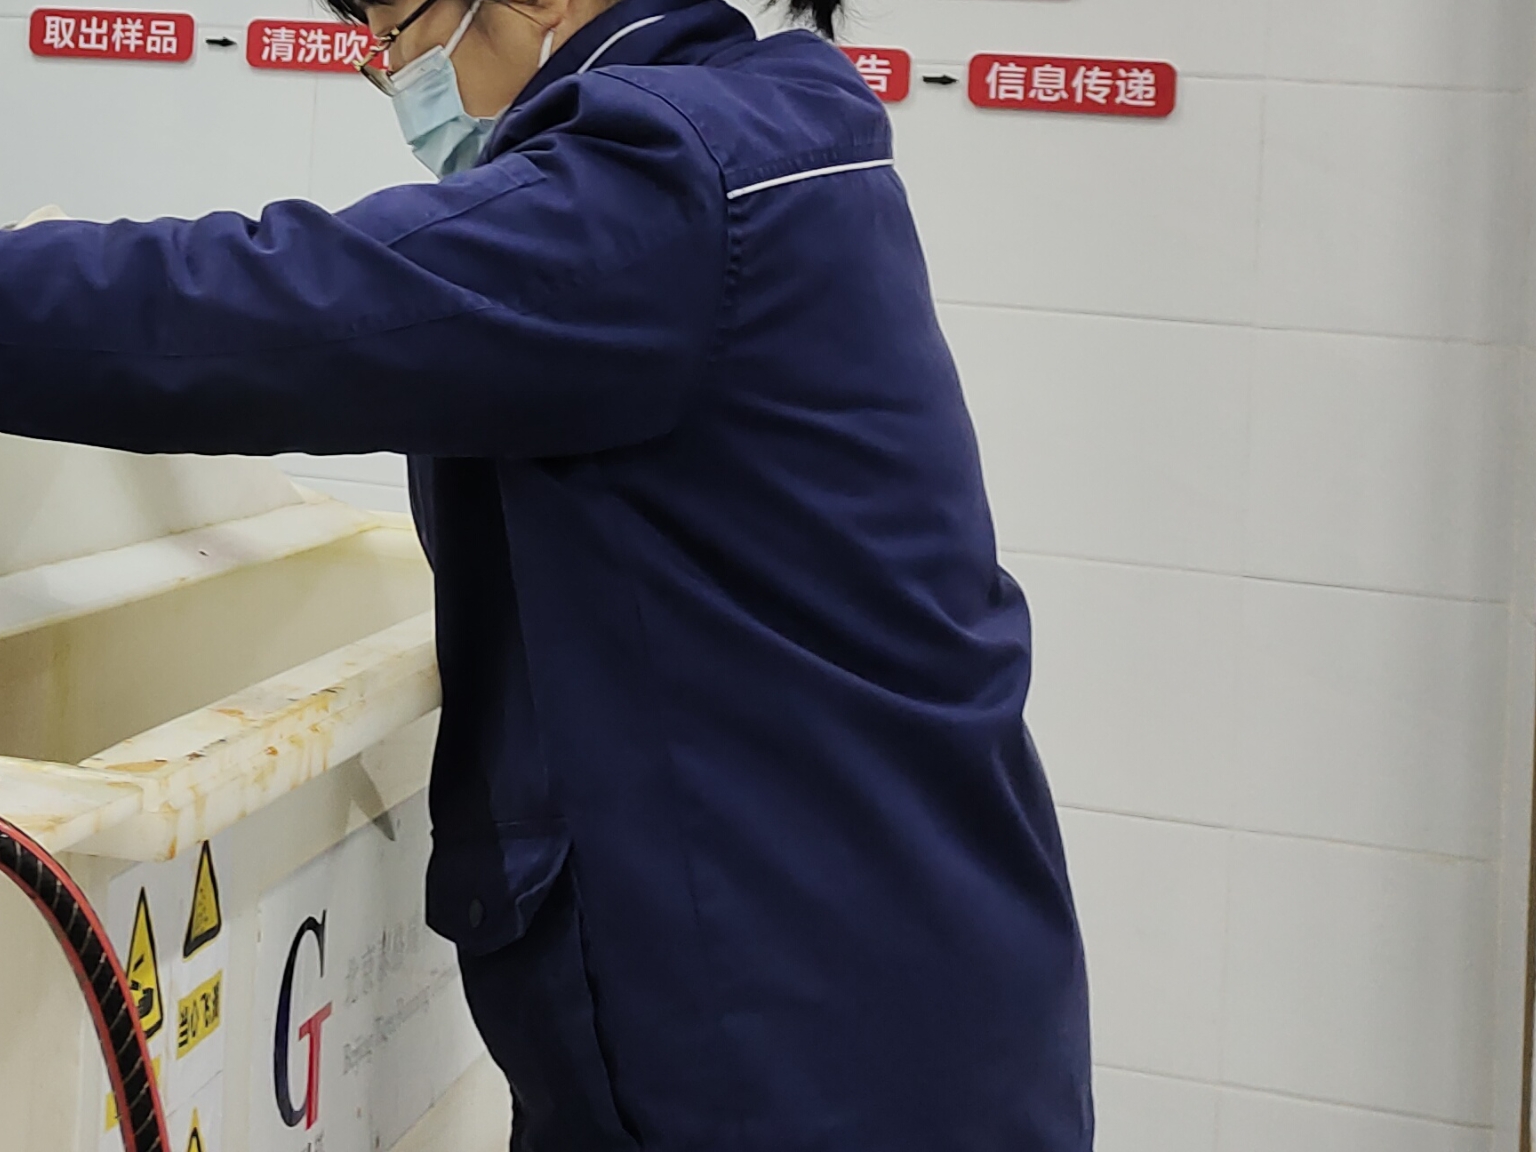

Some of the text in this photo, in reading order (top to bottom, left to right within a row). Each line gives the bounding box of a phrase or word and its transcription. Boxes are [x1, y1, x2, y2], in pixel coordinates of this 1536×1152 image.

[44, 17, 177, 55] 取出样品
[986, 63, 1157, 107] 信息传递
